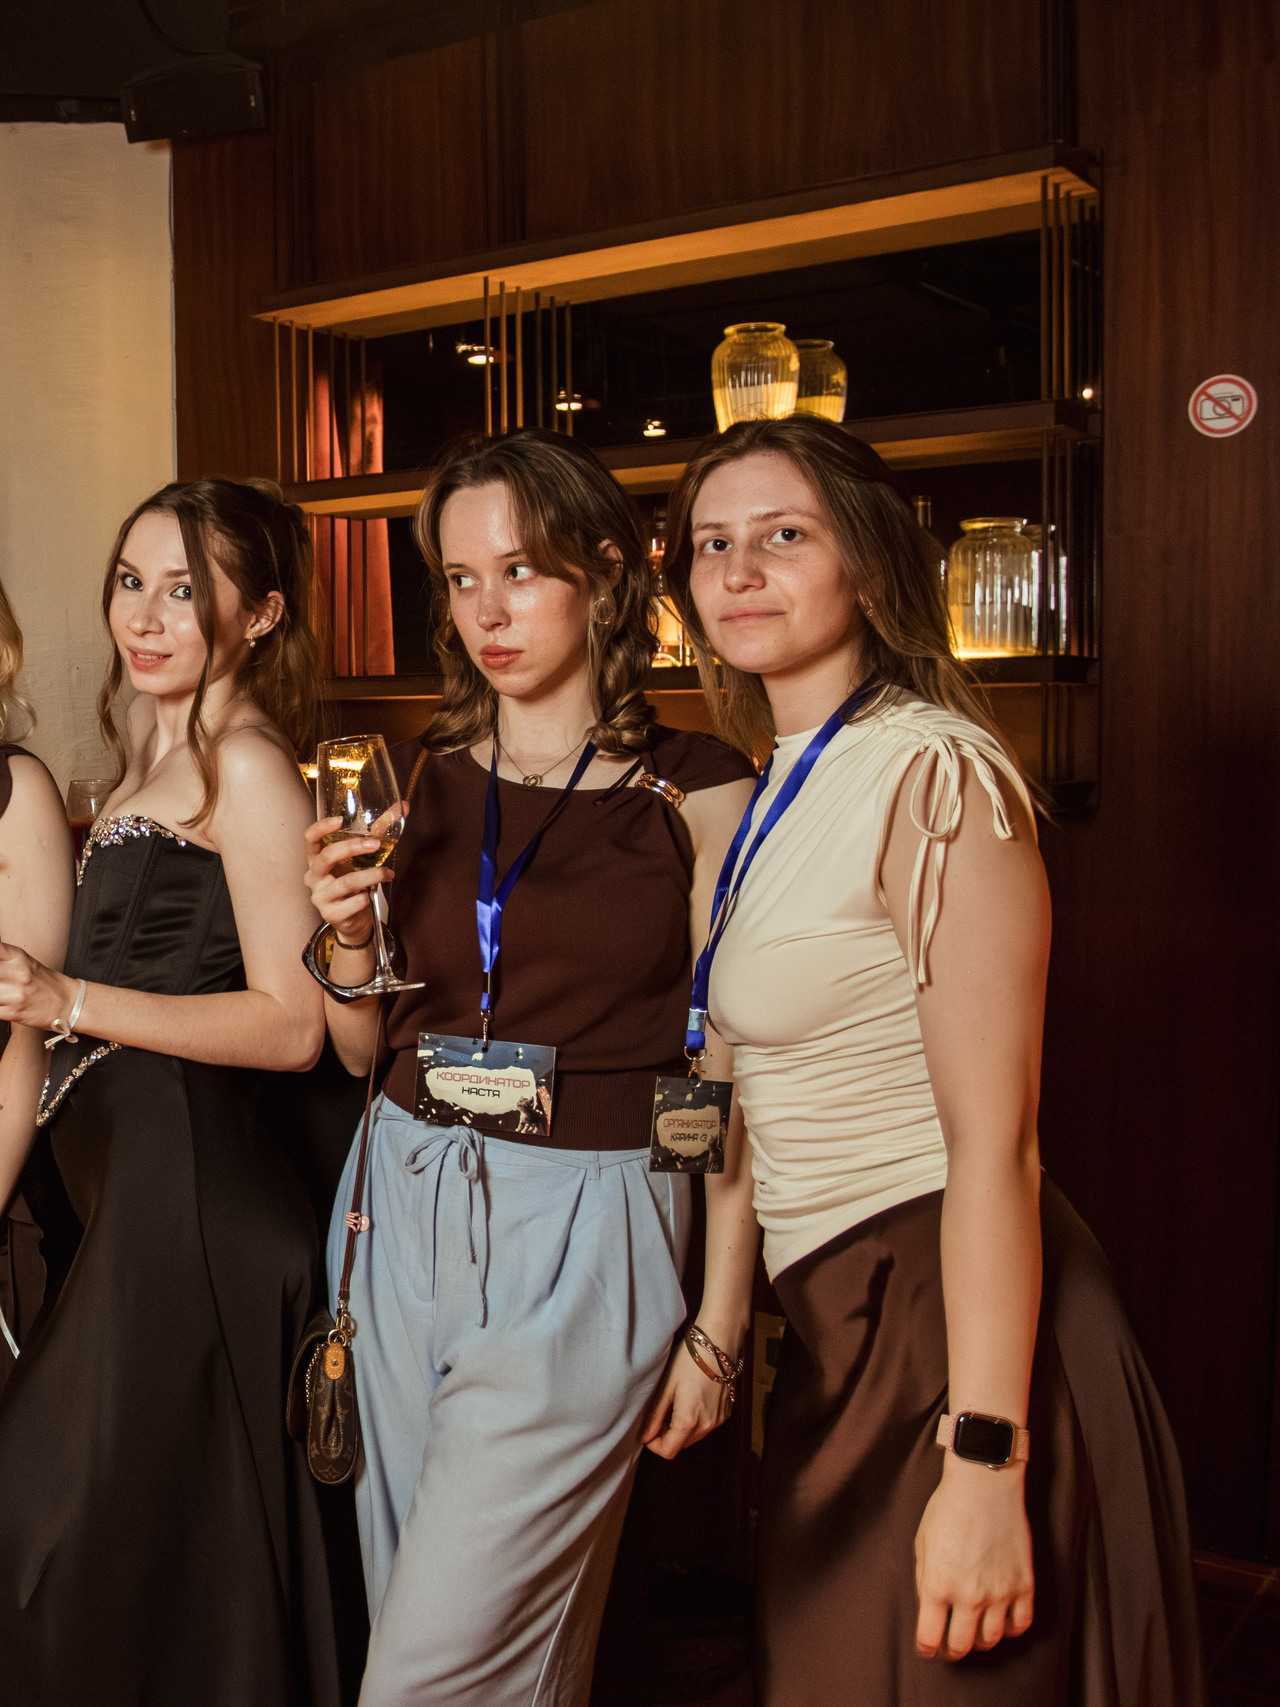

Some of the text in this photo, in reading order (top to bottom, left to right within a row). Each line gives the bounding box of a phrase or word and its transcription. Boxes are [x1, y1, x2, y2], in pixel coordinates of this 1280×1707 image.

[436, 1071, 531, 1089] КООРДИНАТОР
[461, 1086, 501, 1098] НАСТЯ
[670, 1132, 698, 1142] КАРИНА
